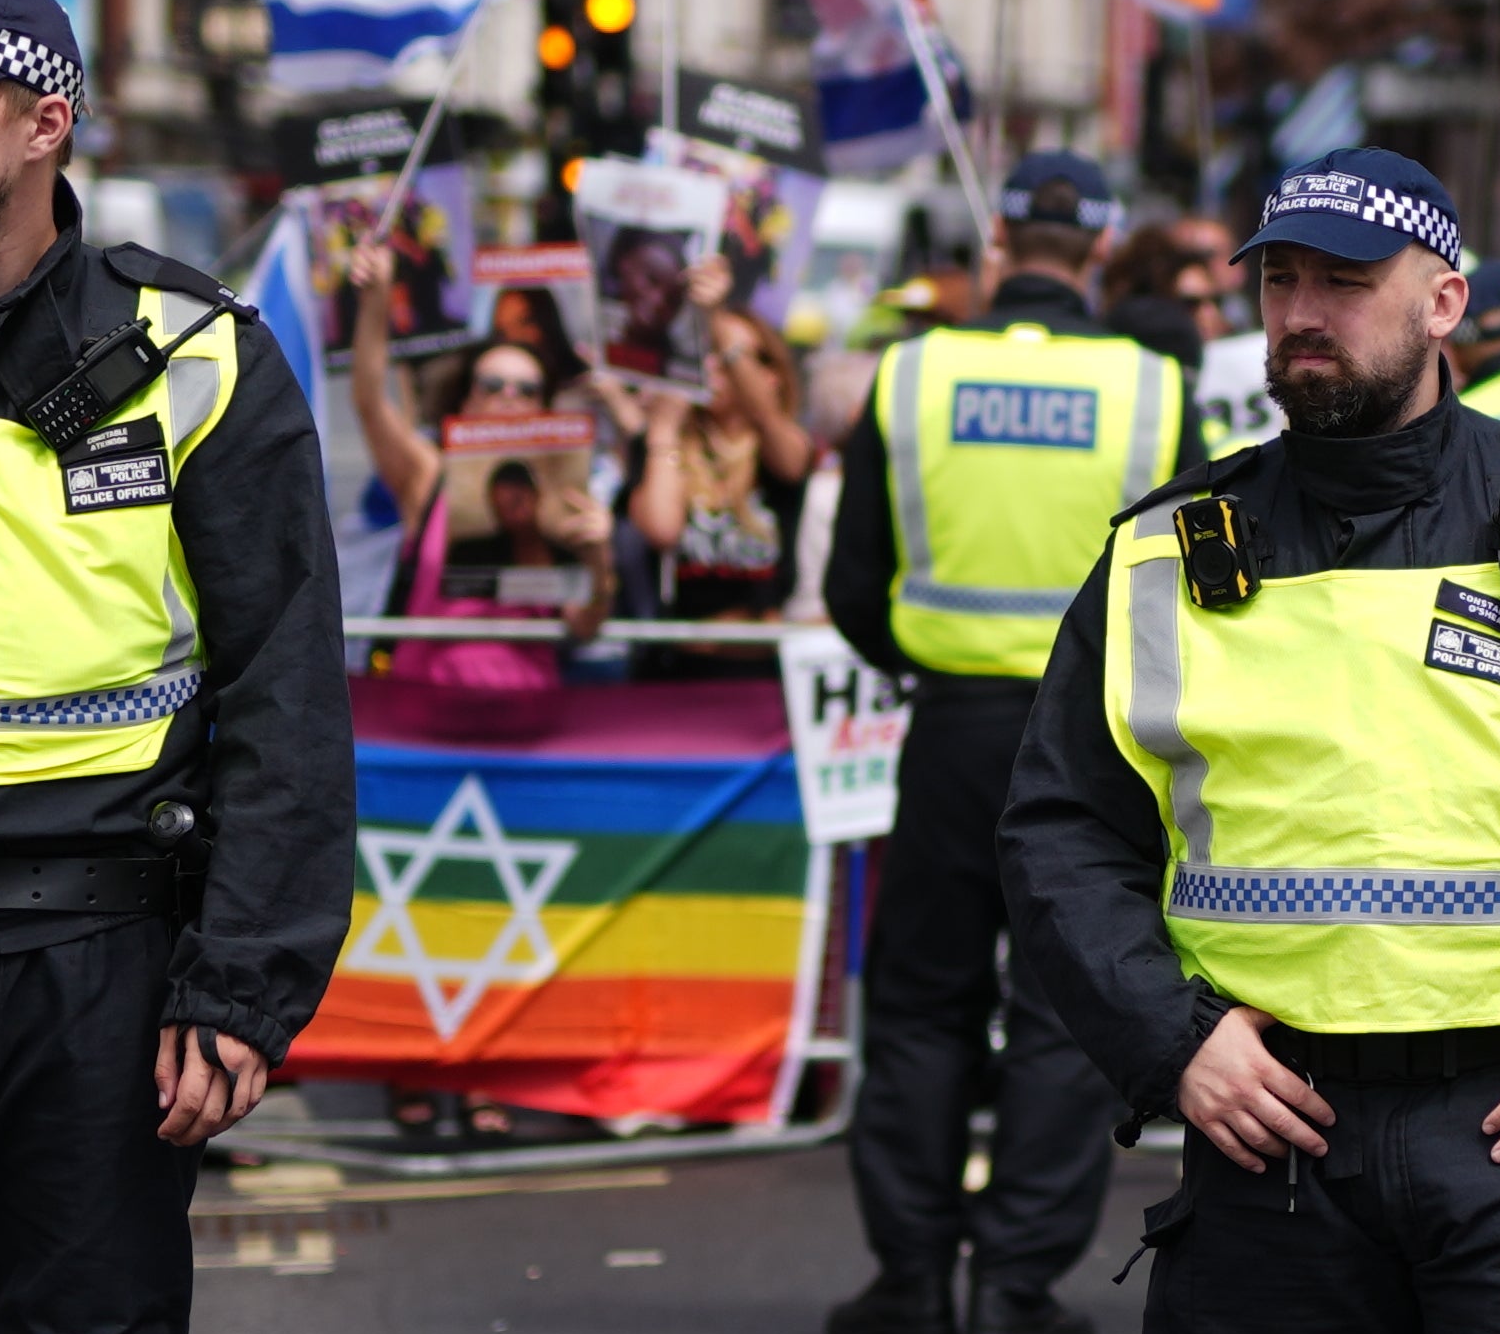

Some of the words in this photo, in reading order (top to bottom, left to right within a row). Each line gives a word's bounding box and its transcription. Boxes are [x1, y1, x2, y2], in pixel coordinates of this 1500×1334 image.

[1308, 182, 1348, 194] POLICE
[1275, 198, 1307, 213] POLICE
[1309, 198, 1359, 214] OFFICER
[956, 387, 1093, 441] POLICE
[101, 460, 156, 474] METROPOLITAN
[110, 469, 151, 483] POLICE
[71, 490, 114, 507] POLICE
[117, 484, 166, 500] OFFICER
[1432, 650, 1475, 668] POLICE
